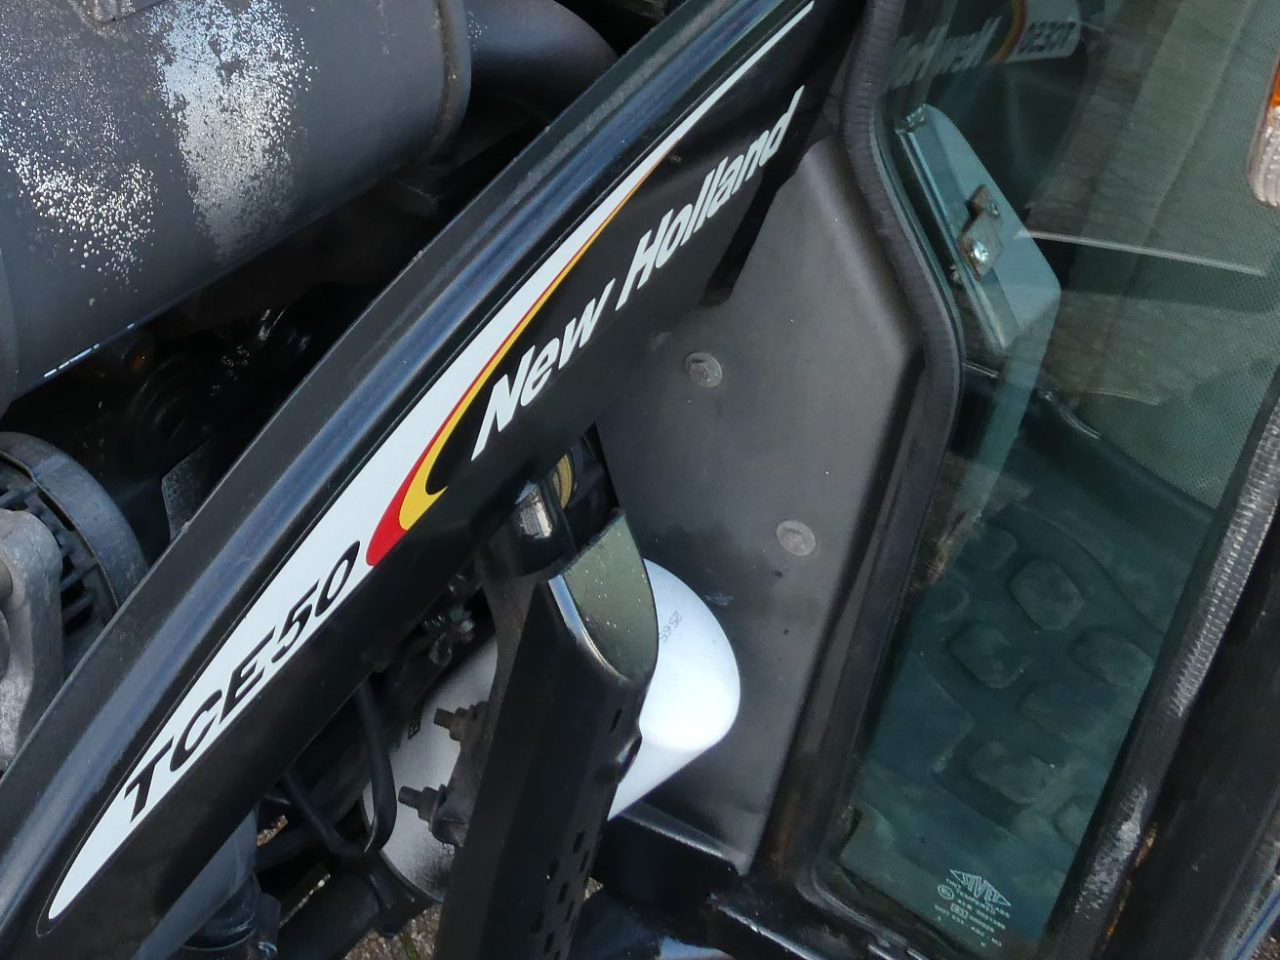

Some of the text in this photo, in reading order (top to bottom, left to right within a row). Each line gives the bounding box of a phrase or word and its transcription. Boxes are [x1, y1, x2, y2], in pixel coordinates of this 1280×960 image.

[471, 85, 804, 461] New Holland
[124, 540, 361, 822] TCE50
